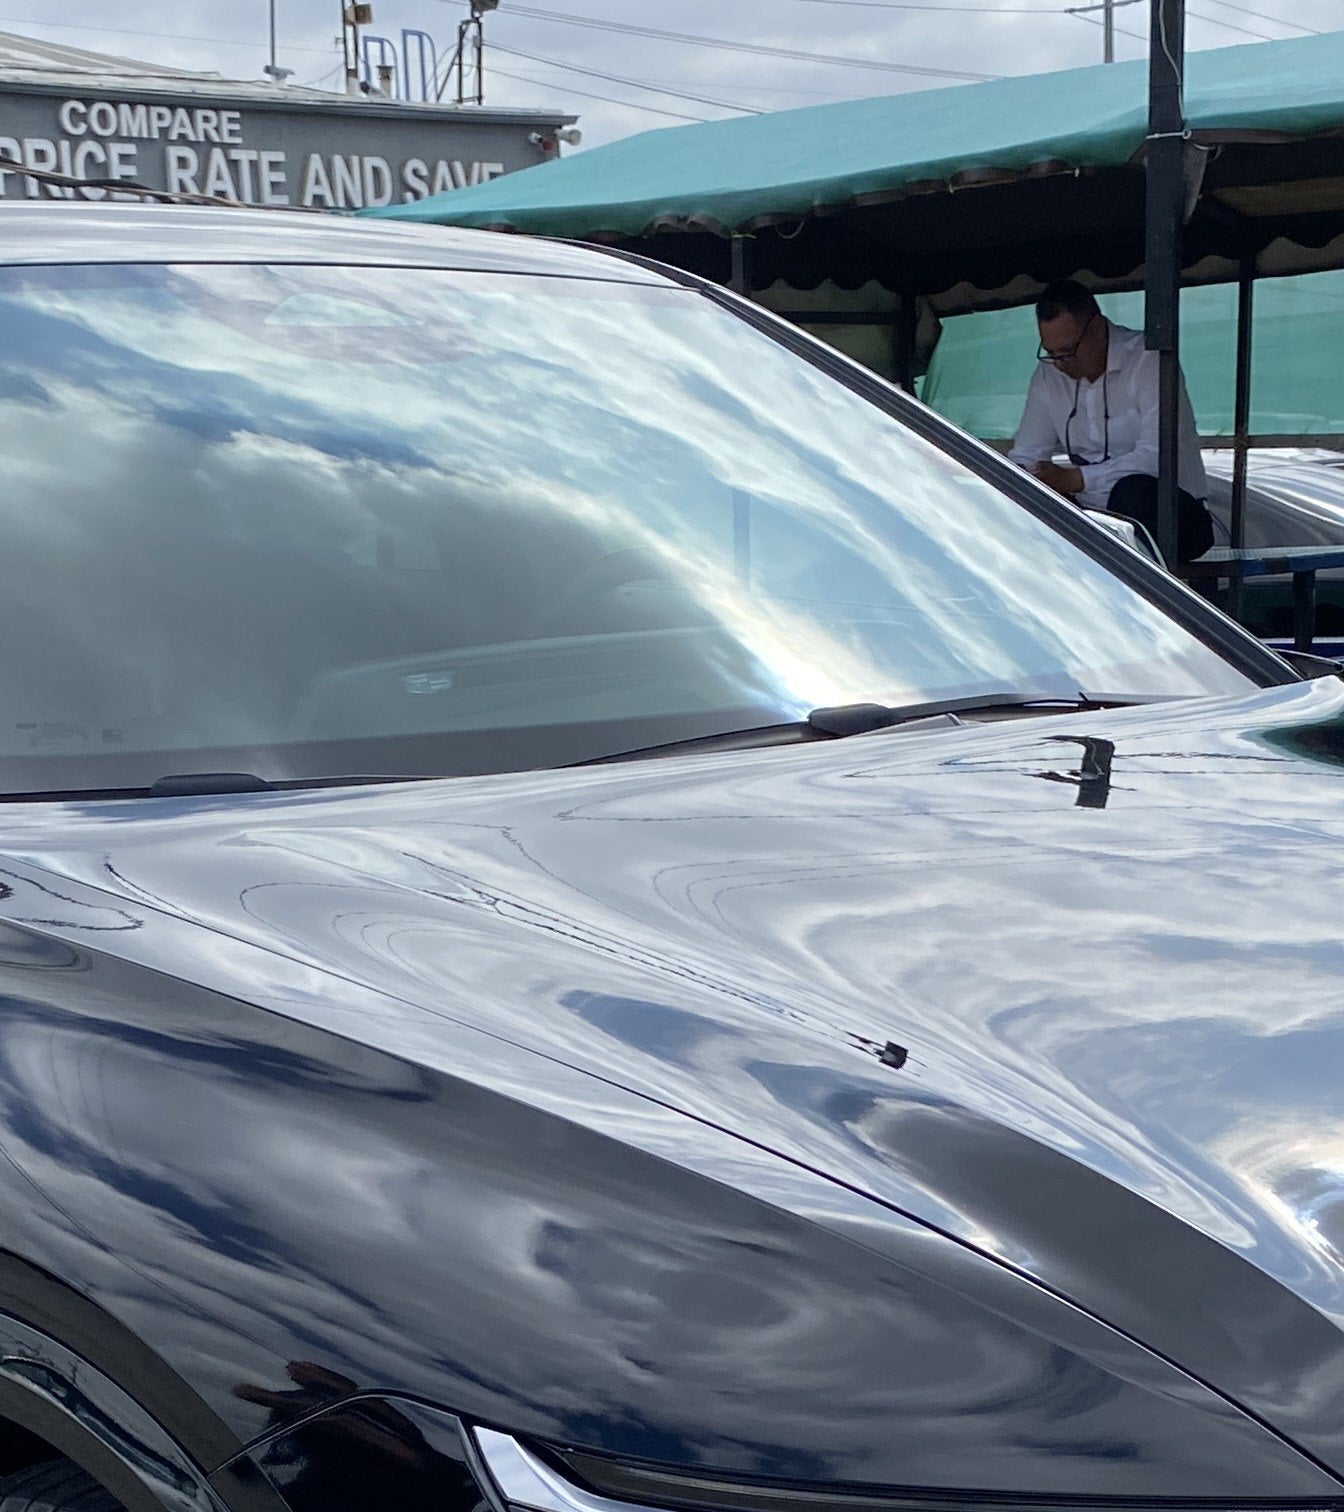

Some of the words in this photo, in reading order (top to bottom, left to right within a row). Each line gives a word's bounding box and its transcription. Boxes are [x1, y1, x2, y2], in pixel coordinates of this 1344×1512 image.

[59, 100, 243, 144] COMPARE
[166, 146, 290, 205] RATE
[301, 153, 394, 208] AND
[402, 158, 504, 204] SAVE
